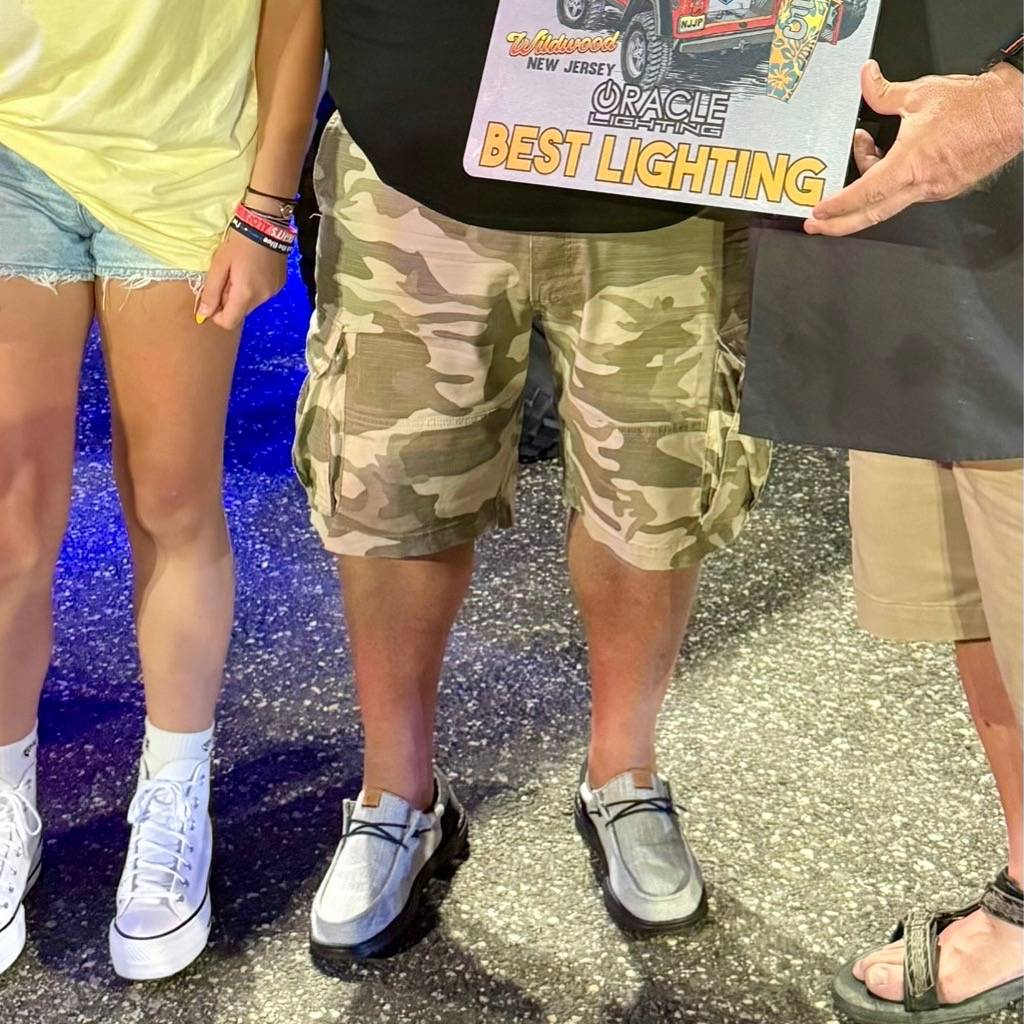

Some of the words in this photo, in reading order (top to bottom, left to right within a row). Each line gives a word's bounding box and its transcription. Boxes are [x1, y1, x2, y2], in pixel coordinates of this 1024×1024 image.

[681, 17, 705, 28] NJJP
[506, 29, 621, 57] Wildwood
[526, 56, 560, 72] NEW
[563, 60, 616, 77] JERSEY
[591, 78, 731, 126] ORACLE
[587, 111, 724, 138] LIGHTING
[479, 121, 593, 177] BEST
[595, 134, 828, 207] LIGHTING
